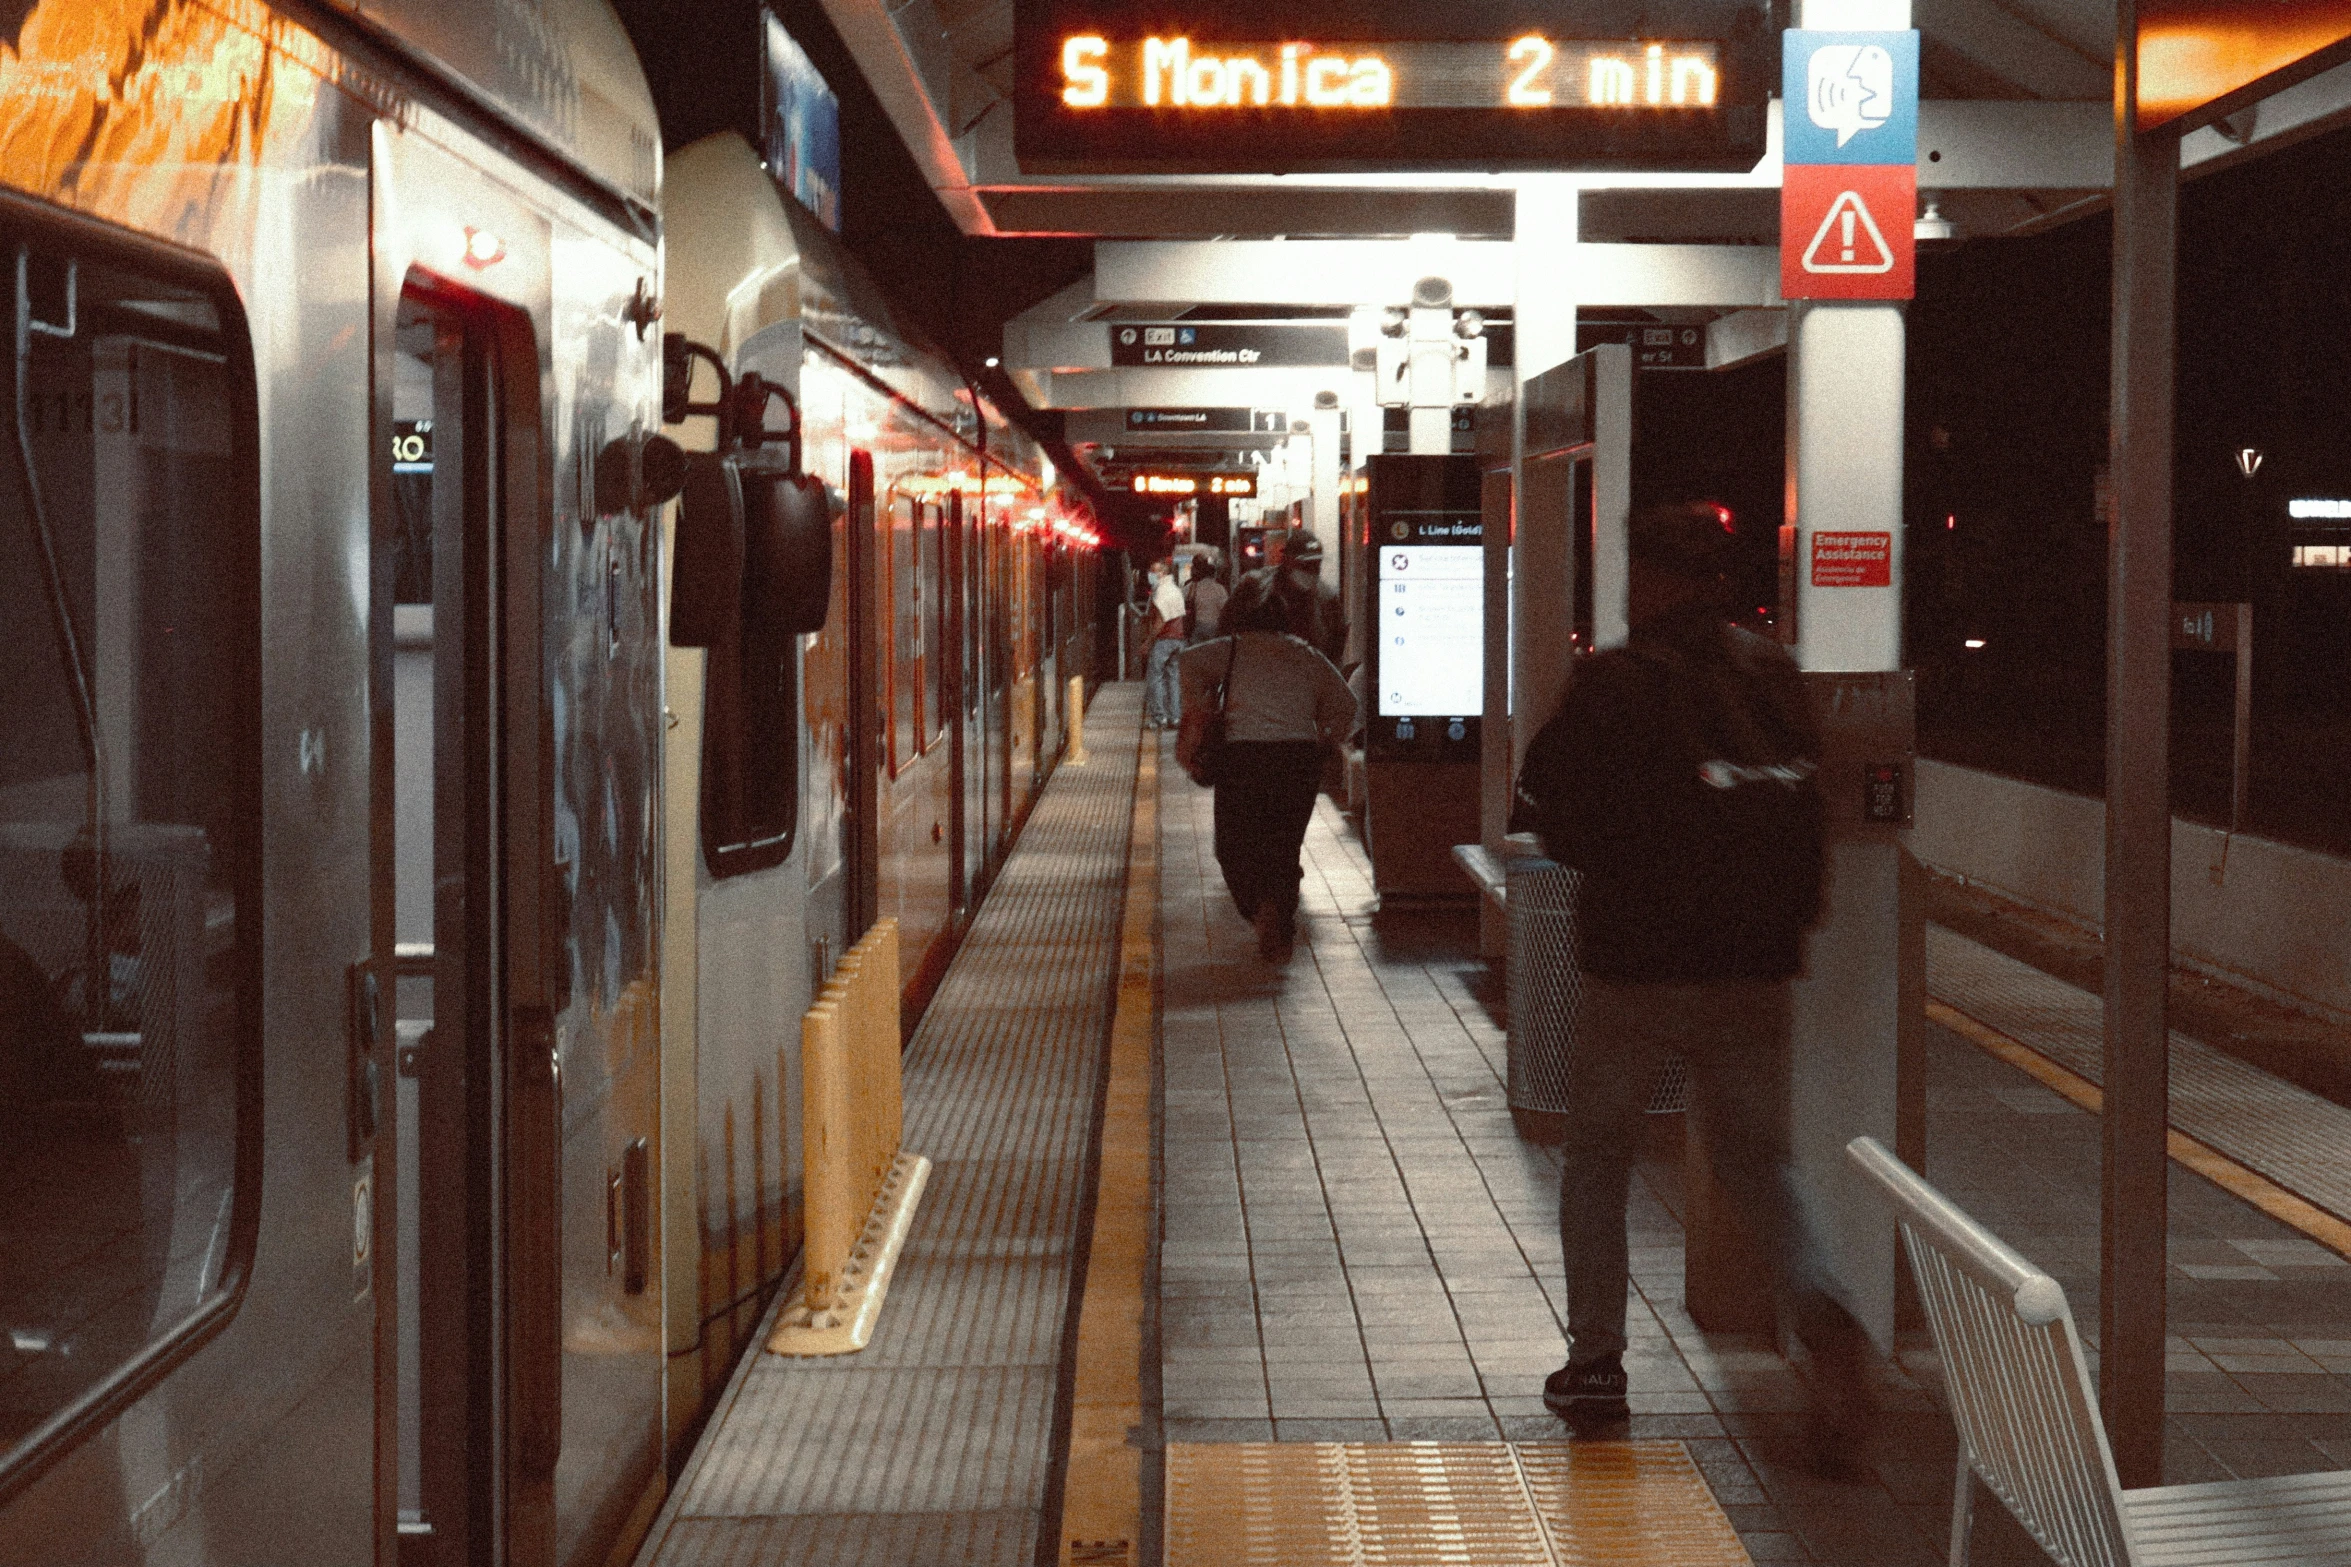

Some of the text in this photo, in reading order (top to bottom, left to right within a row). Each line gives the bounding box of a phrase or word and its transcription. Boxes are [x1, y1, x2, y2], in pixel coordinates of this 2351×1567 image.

[1062, 35, 1717, 107] S Monica 2 min
[1144, 348, 1261, 363] LA Convention Ctr
[1418, 525, 1426, 535] L
[1427, 524, 1450, 535] Line
[1816, 534, 1888, 548] Emergency
[1816, 548, 1885, 560] Assistance
